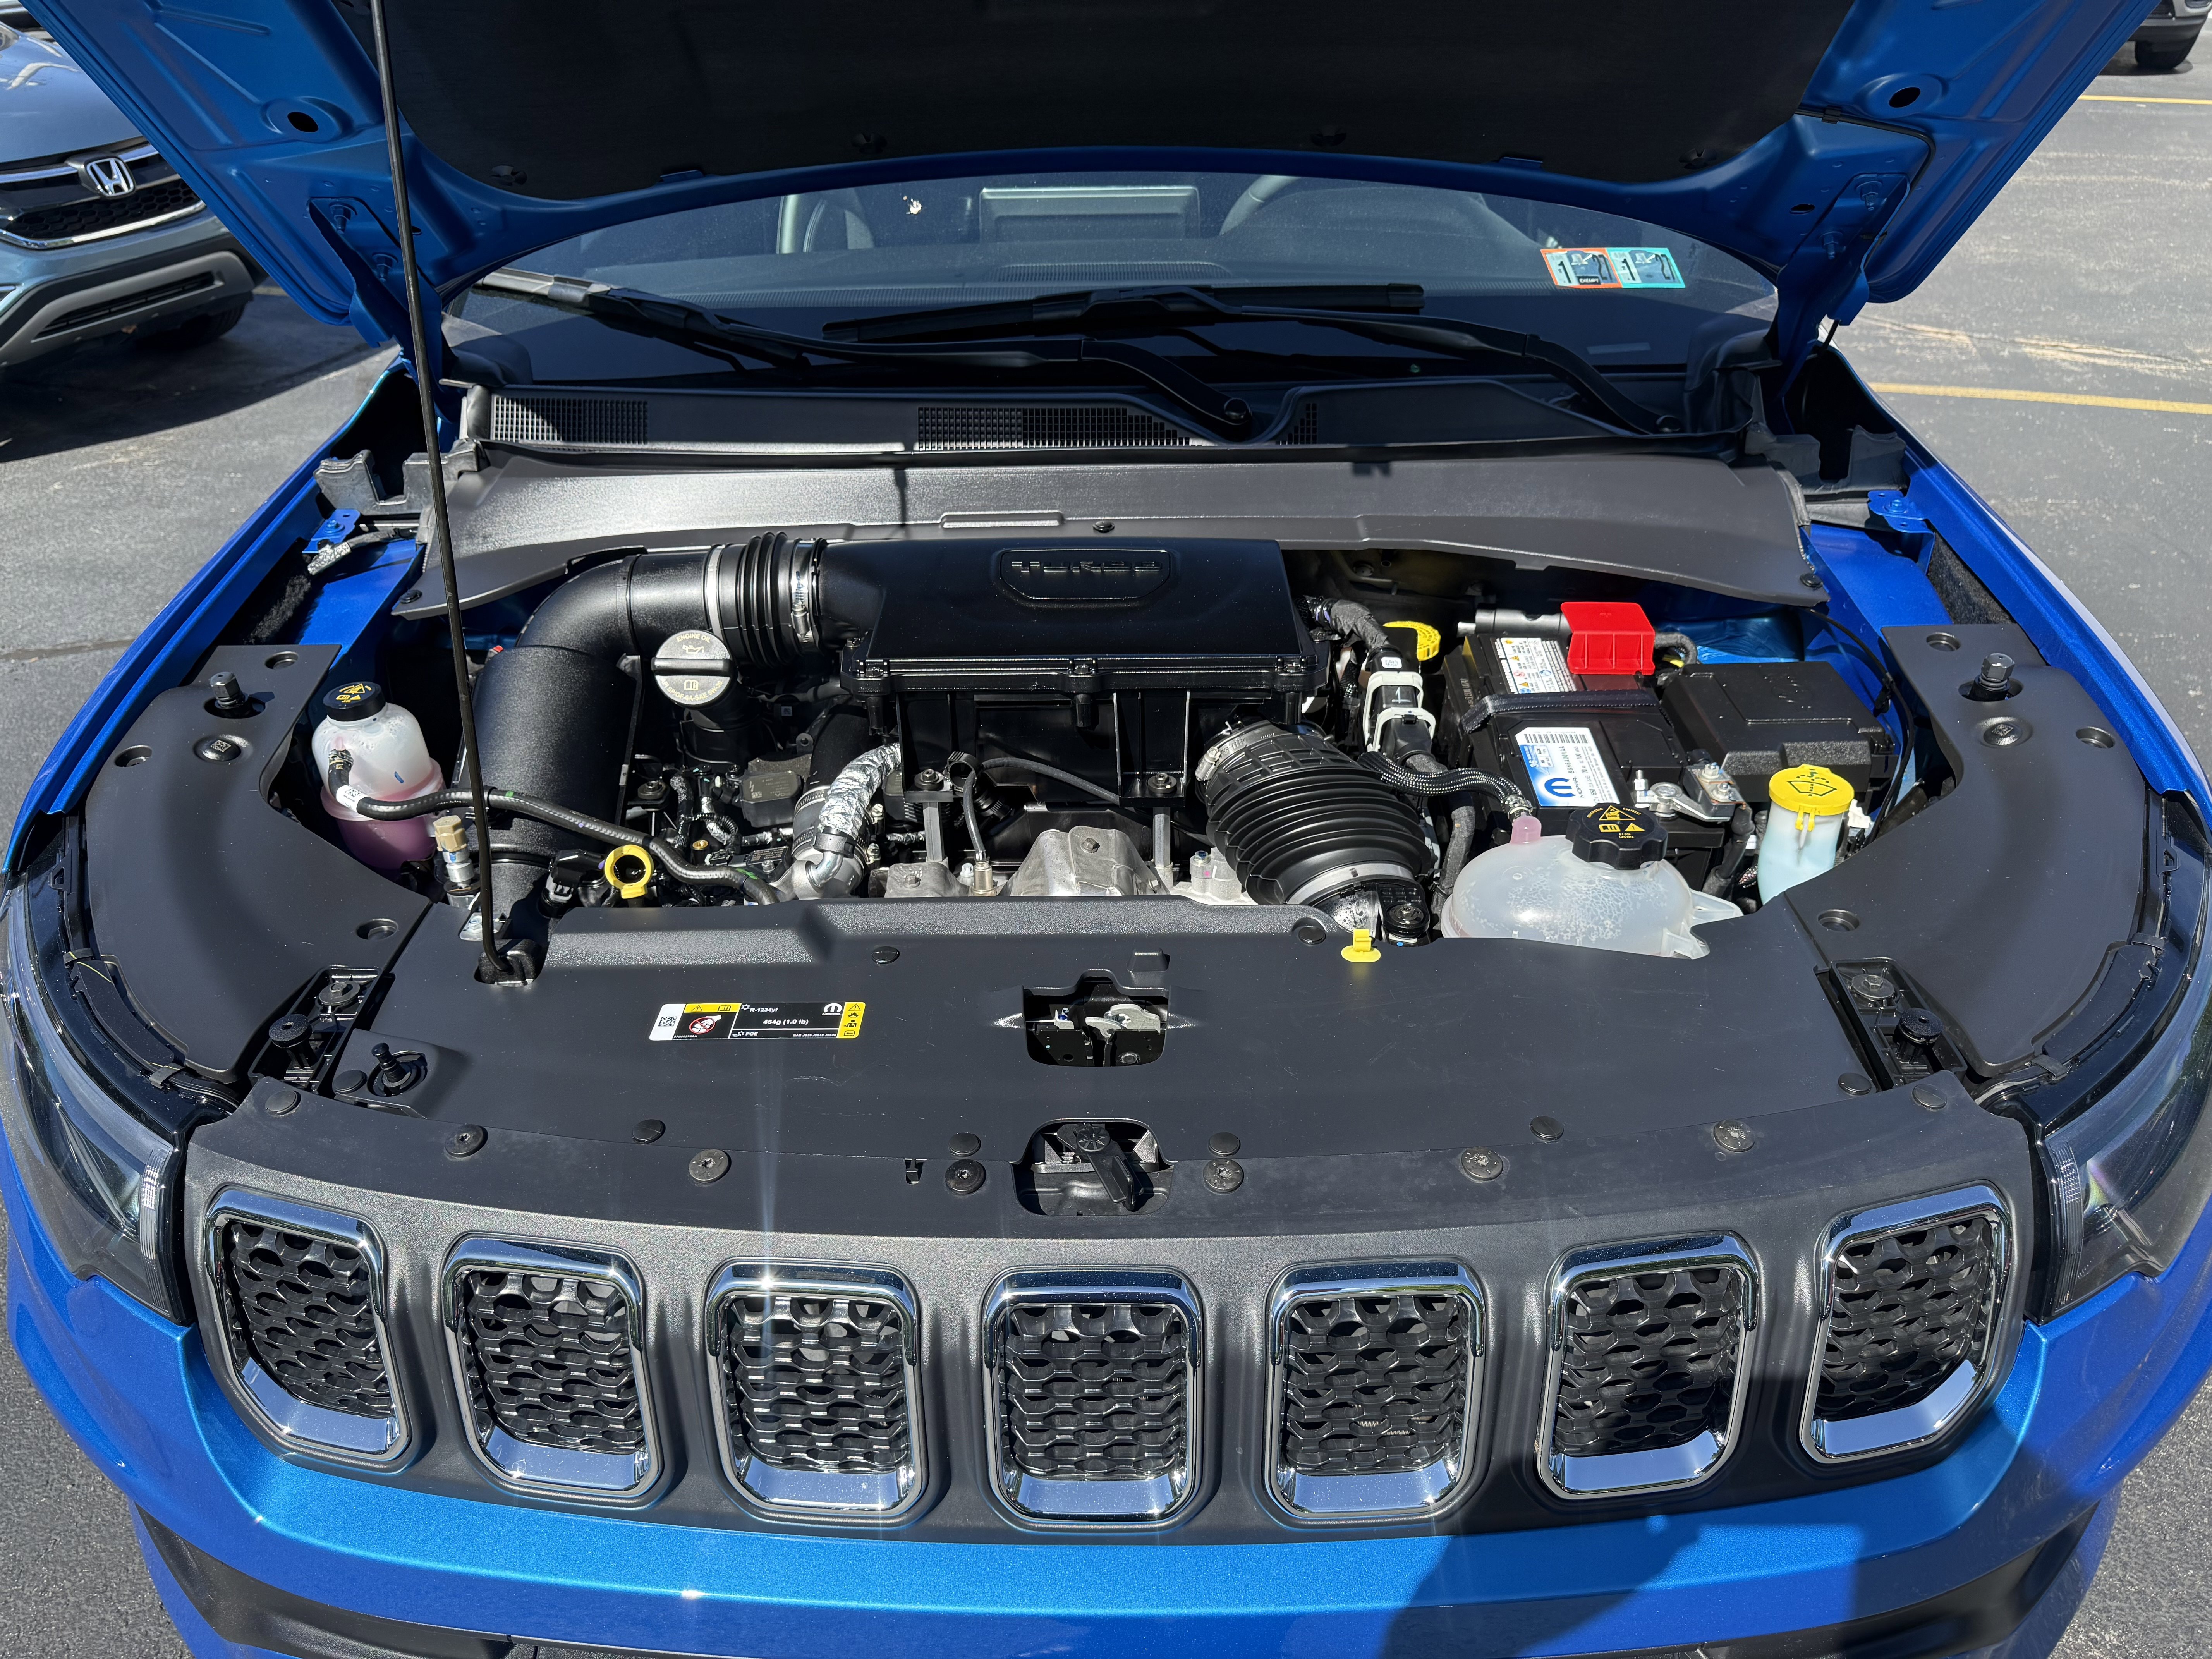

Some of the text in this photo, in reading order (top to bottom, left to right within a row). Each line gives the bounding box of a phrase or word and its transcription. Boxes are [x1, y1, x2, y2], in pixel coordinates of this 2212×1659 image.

[1558, 254, 1613, 283] 1 27
[1621, 254, 1675, 281] 1 27
[1012, 561, 1161, 572] TURBO
[676, 633, 711, 643] ENGINE OIL
[660, 678, 670, 689] API
[1528, 759, 1539, 768] 36
